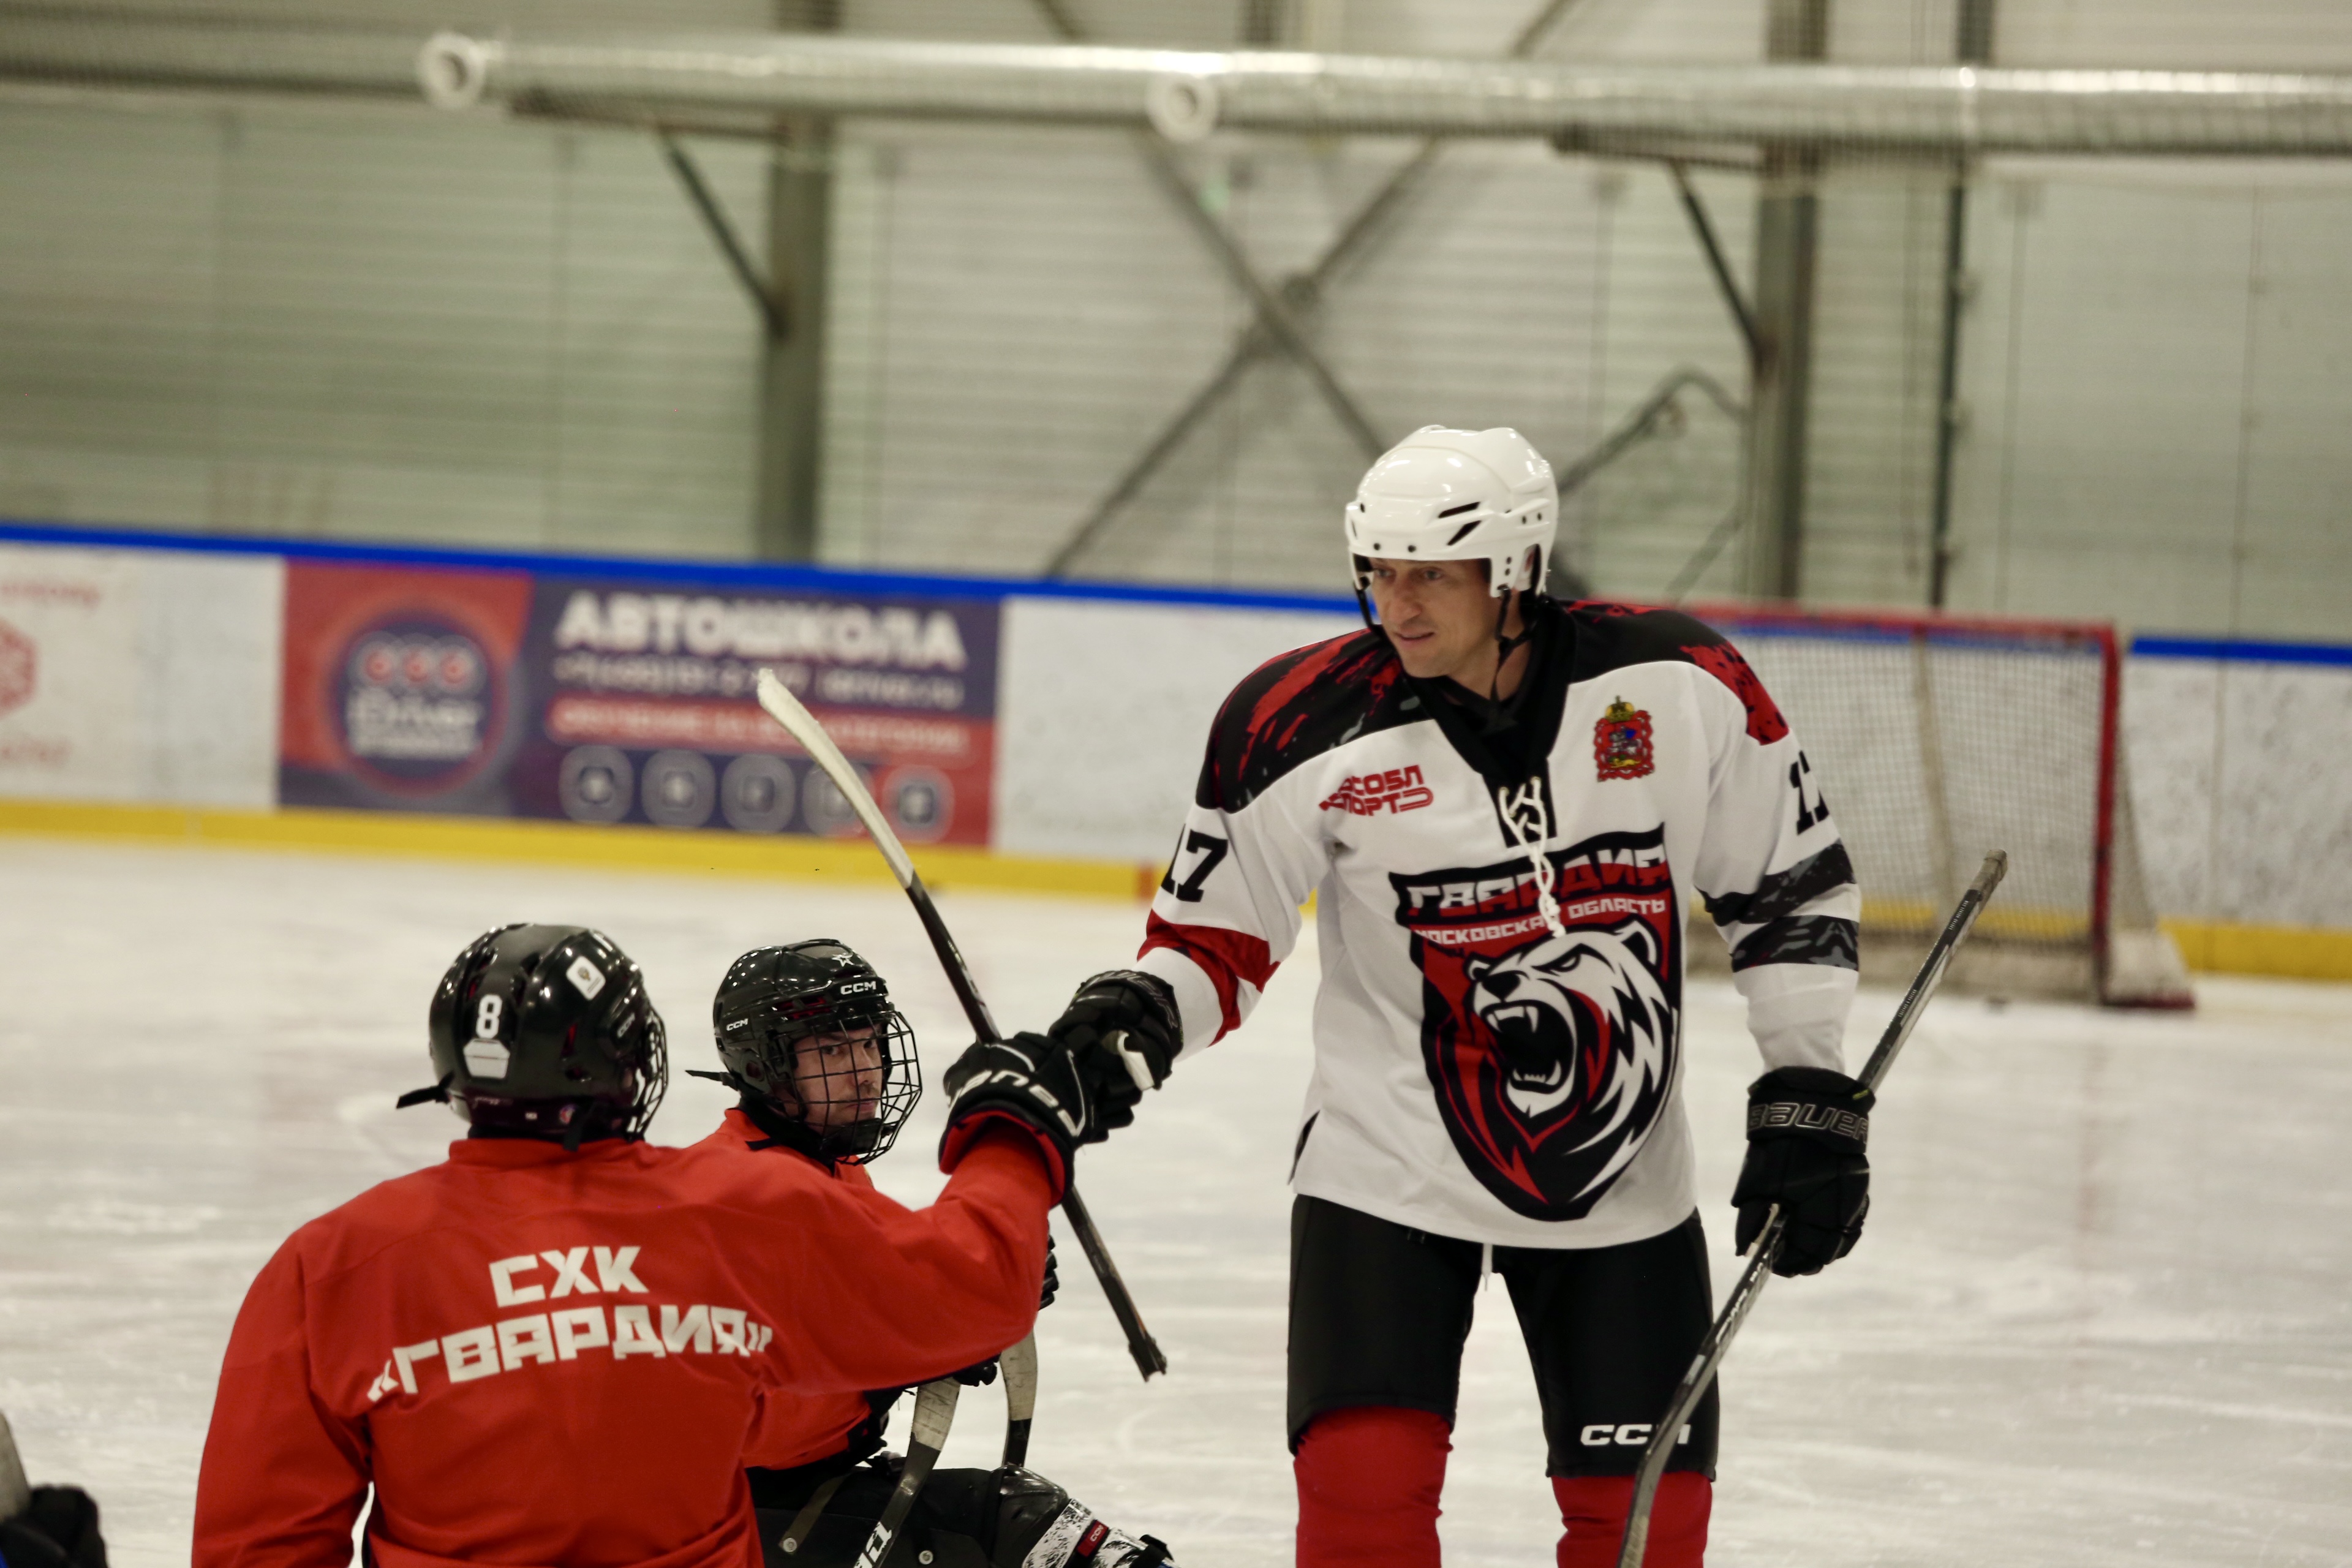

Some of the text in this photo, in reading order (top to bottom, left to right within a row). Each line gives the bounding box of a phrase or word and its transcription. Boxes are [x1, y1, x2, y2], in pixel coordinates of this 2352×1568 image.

[554, 590, 967, 671] АВТОШКОЛА
[1415, 897, 1666, 945] МОСКОВСКА ОБЛАСТЬ
[840, 980, 878, 995] CCM
[476, 993, 503, 1039] 8
[726, 1018, 749, 1031] CCM
[489, 1246, 650, 1308] СХК
